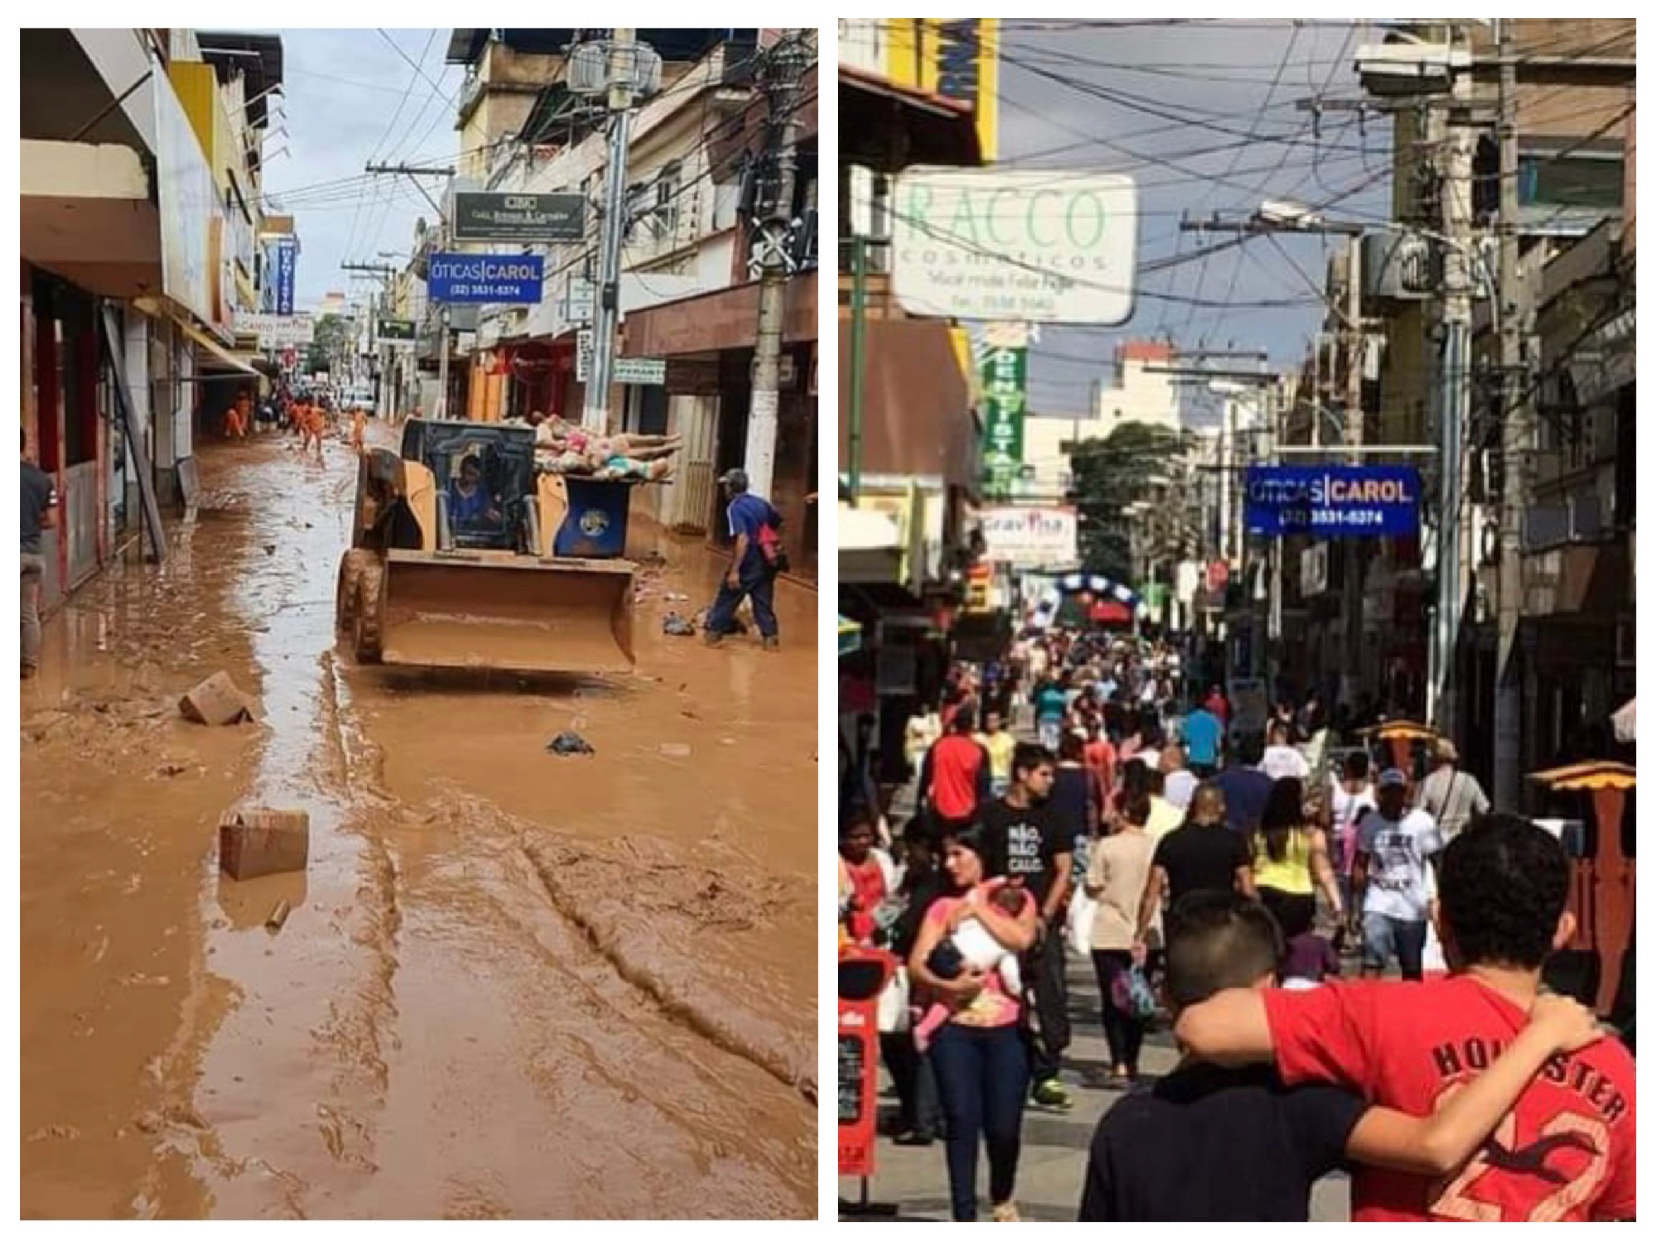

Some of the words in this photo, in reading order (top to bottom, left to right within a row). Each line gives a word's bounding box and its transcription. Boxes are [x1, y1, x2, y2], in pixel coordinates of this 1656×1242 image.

[908, 182, 1105, 249] RACCO
[486, 264, 540, 280] CAROL
[1331, 479, 1415, 502] CAROL
